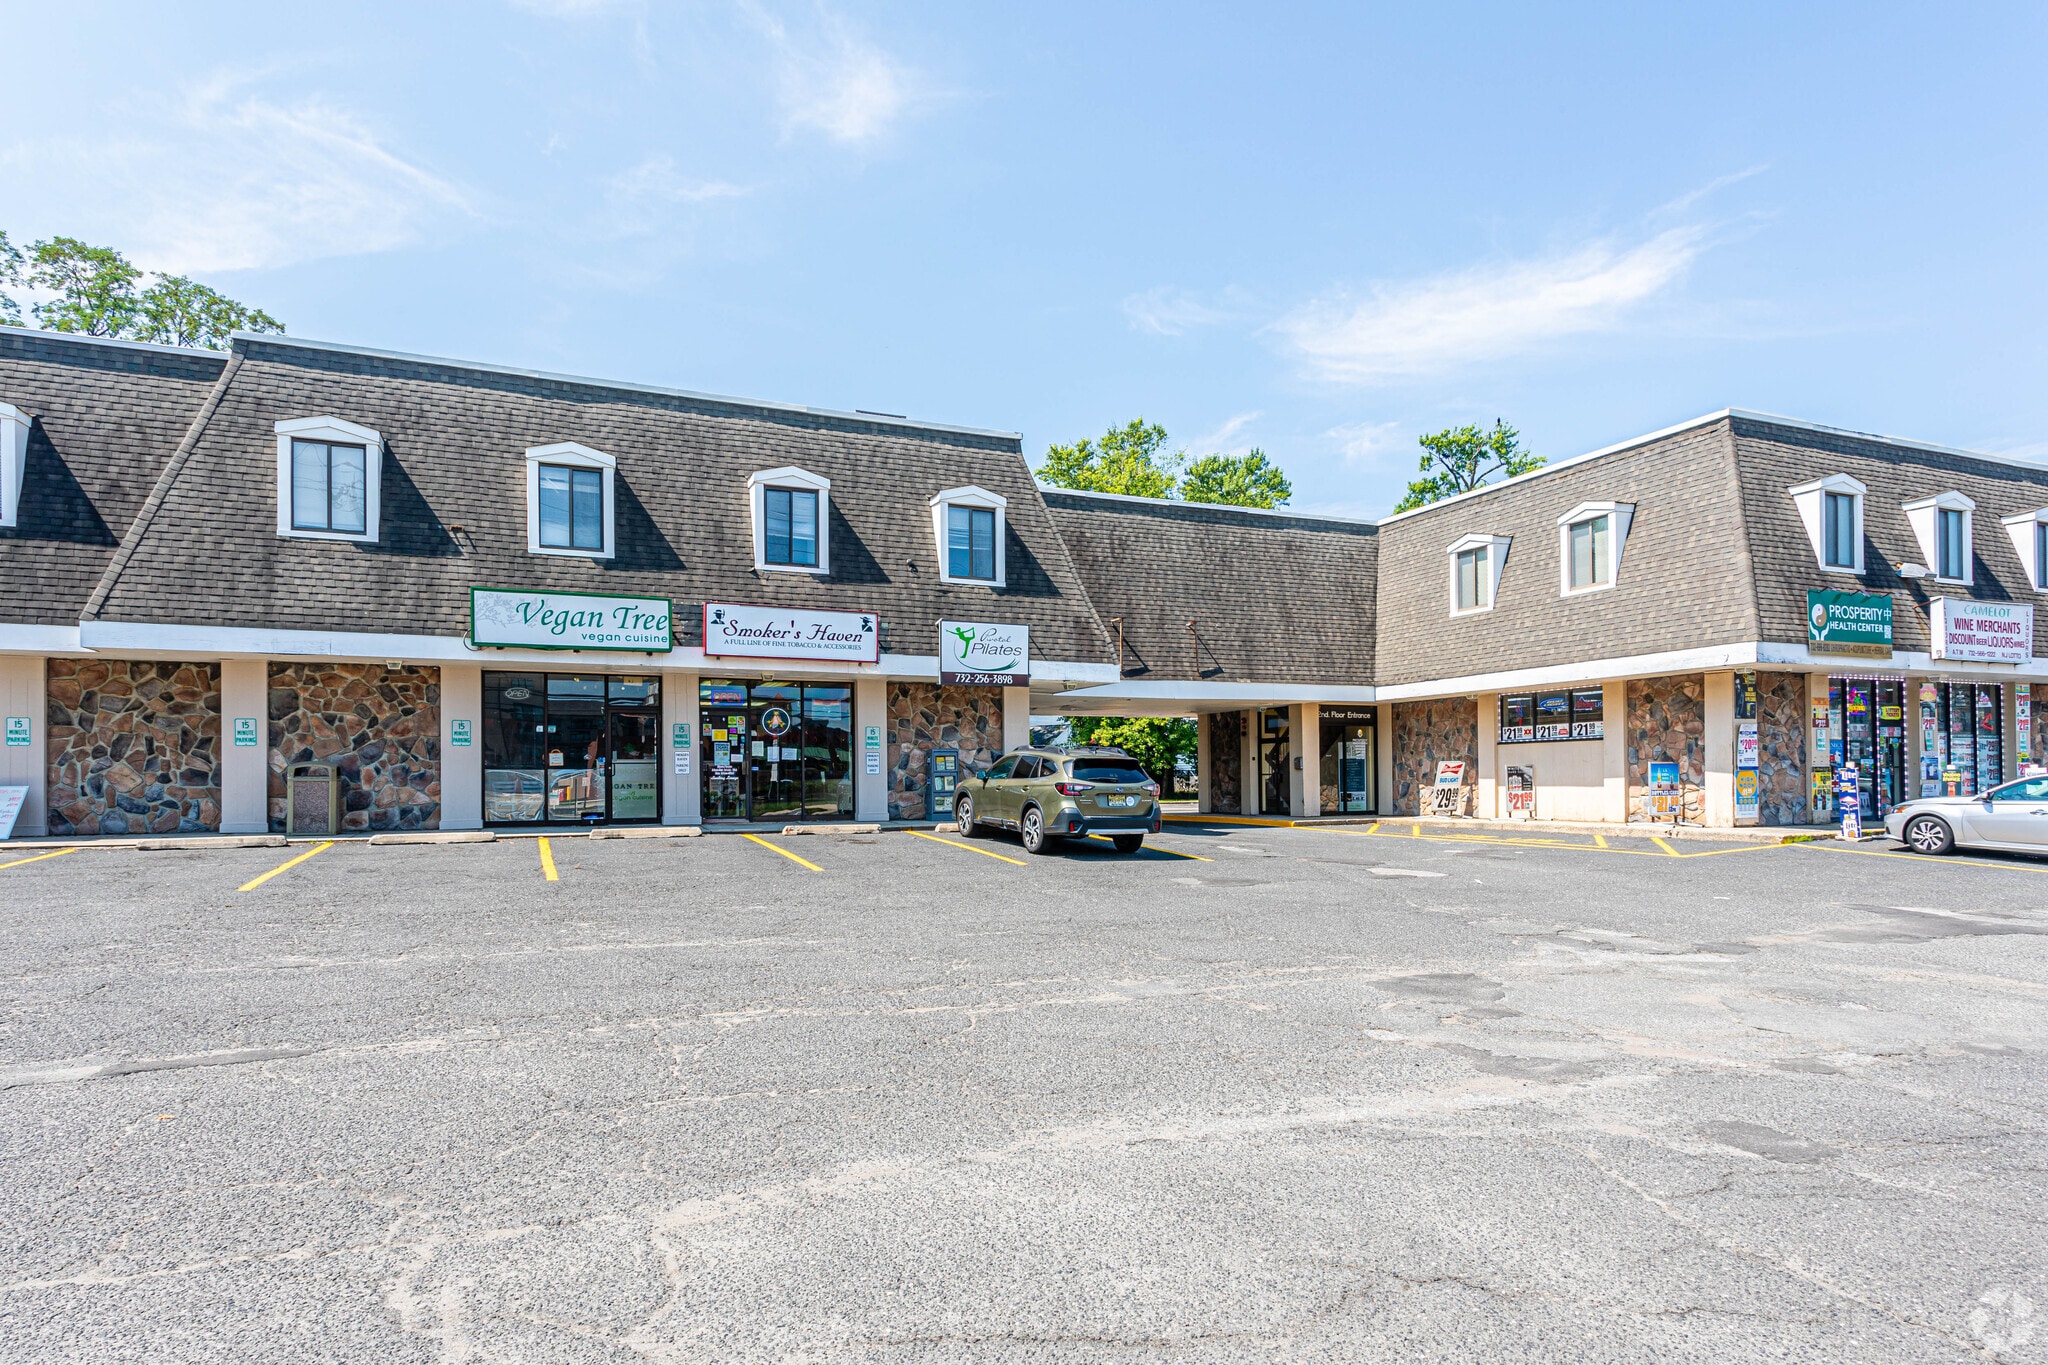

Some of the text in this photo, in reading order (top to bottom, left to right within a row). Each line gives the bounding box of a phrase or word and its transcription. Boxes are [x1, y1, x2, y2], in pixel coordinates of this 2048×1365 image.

[1828, 605, 1883, 621] PROSPERITY
[1964, 605, 2011, 617] CAMELOT
[515, 599, 669, 635] Vegan Tree
[723, 619, 863, 643] Smoker's Haven
[1829, 621, 1884, 633] HEALTH CENTER
[1953, 618, 2021, 635] WINE MERCHANTS
[581, 632, 669, 643] vegan cuisine
[979, 627, 1012, 642] Pivotal
[787, 641, 817, 649] TOBACCO
[823, 643, 862, 651] ACCESSORIES
[1949, 633, 1976, 645] DISCOUNT
[1988, 636, 2014, 649] LIQUORS
[971, 642, 1022, 656] Pilates
[955, 673, 1013, 684] 732-256-3898
[509, 688, 528, 698] OPEN
[713, 692, 742, 702] OPEN
[1347, 711, 1371, 719] Entrance
[13, 720, 23, 729] 15
[241, 721, 250, 729] 15
[458, 722, 465, 730] 15
